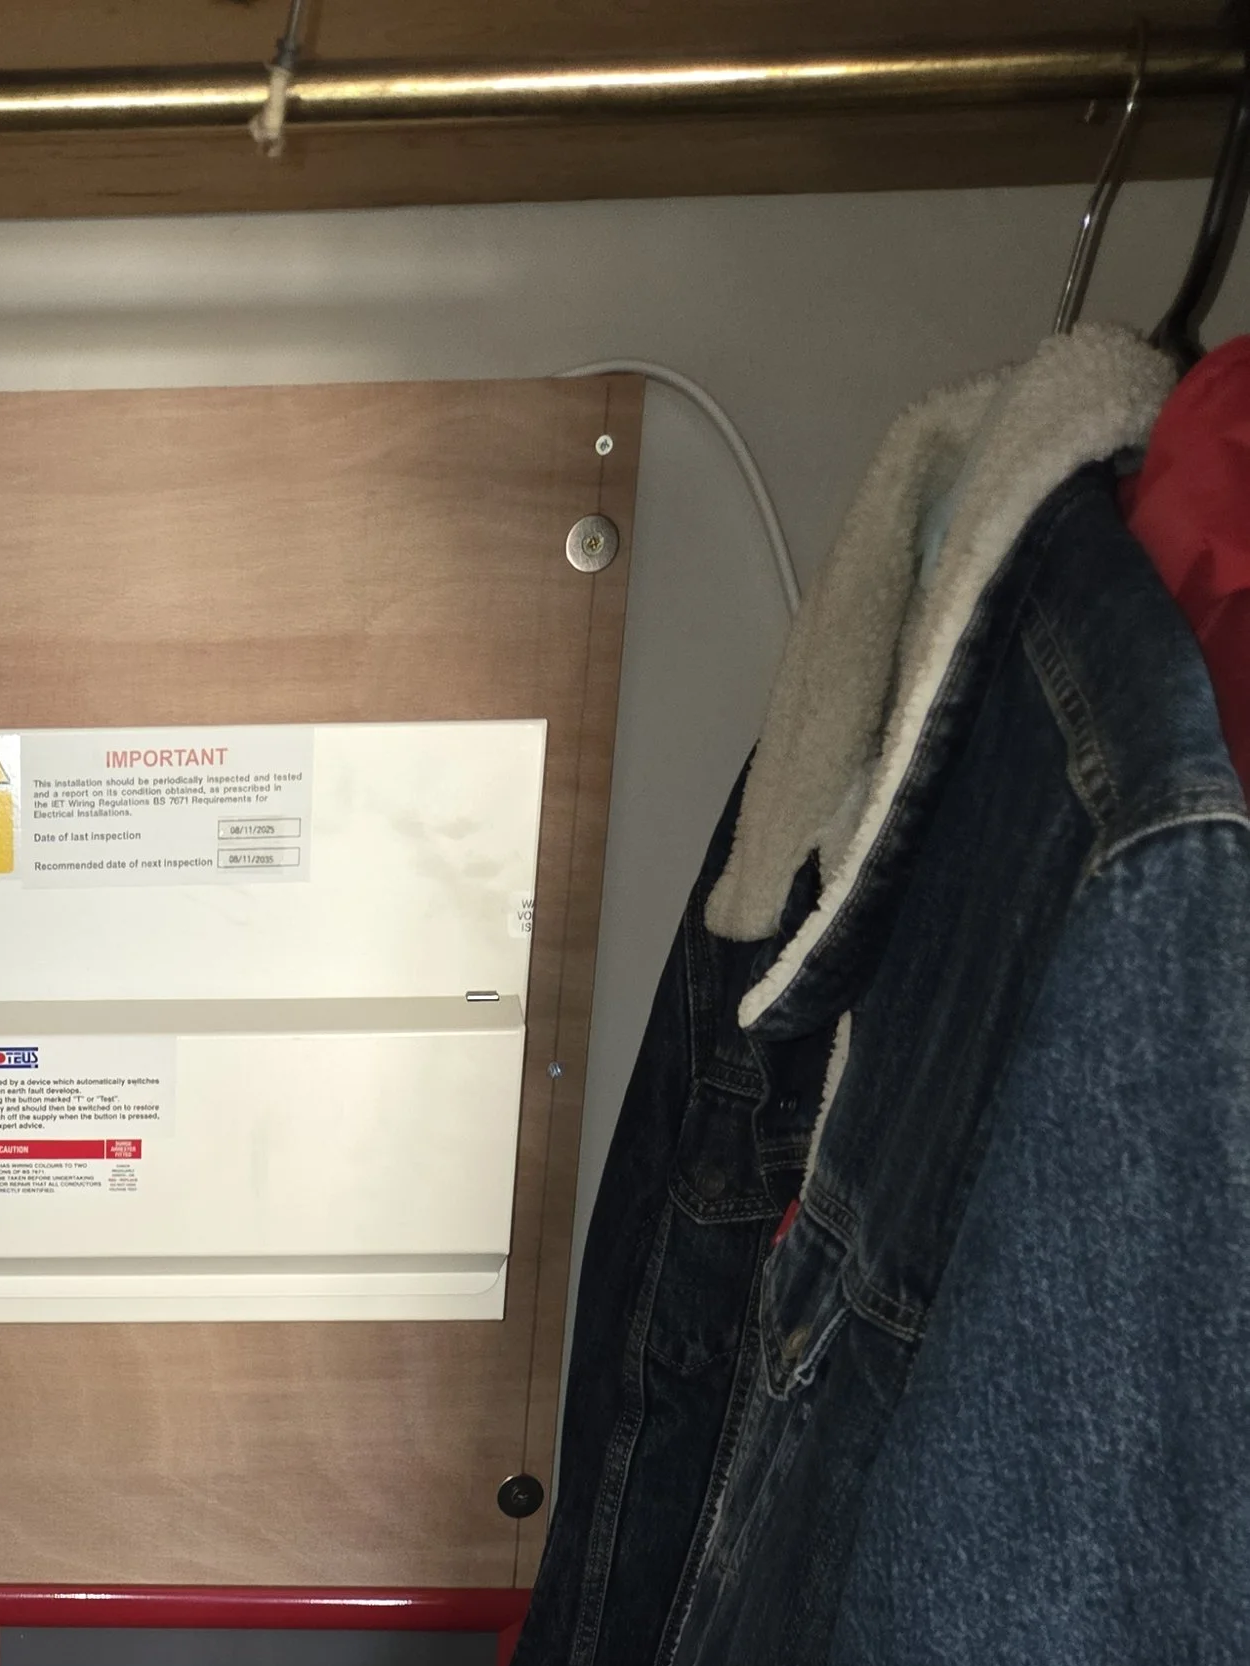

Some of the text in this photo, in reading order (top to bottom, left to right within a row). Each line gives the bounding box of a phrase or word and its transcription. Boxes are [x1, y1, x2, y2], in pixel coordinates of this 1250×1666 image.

[105, 748, 228, 768] IMPORTANT
[34, 772, 302, 788] This installation should be periodically inspected and tested
[33, 790, 49, 798] and
[61, 789, 89, 799] report
[106, 788, 117, 797] its
[121, 787, 161, 796] condition
[223, 784, 270, 794] prescribed
[274, 783, 282, 792] in
[34, 794, 268, 808] the IET Wiring Regulations BS 7671 Requirements for
[34, 830, 141, 843] Date of last inspection
[34, 860, 103, 871] Recommended
[106, 859, 126, 869] date
[129, 859, 139, 868] of
[141, 859, 162, 868] next
[46, 1087, 81, 1095] develops.
